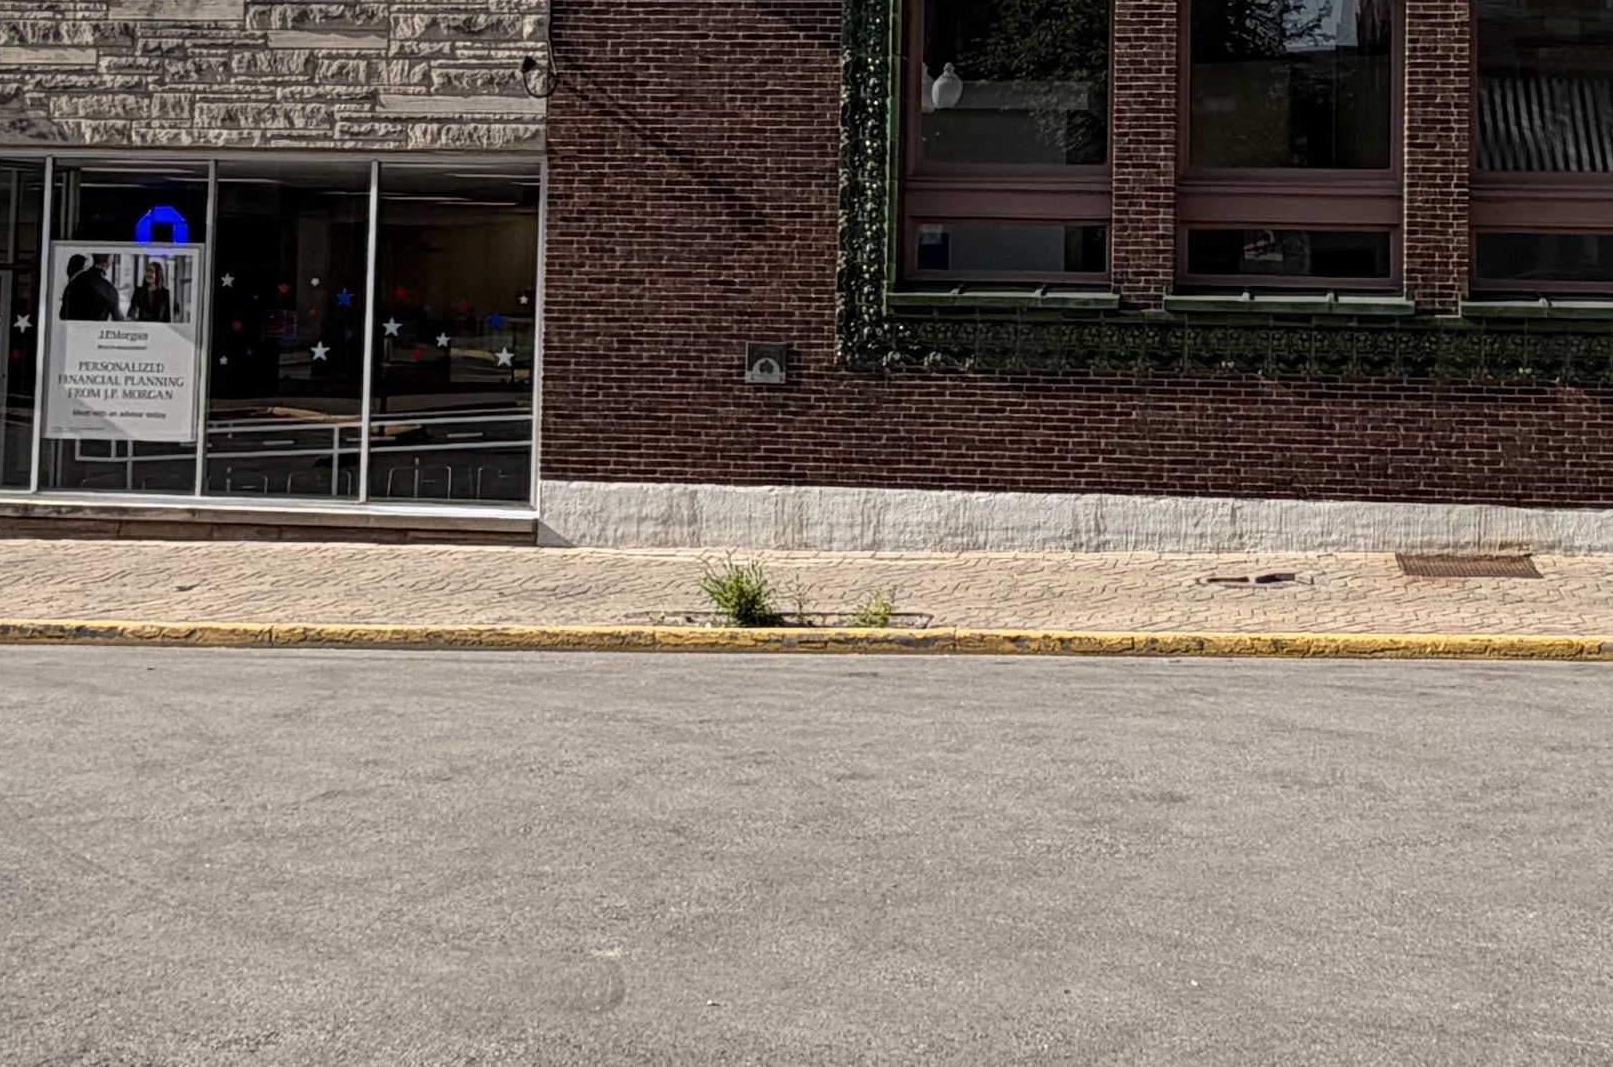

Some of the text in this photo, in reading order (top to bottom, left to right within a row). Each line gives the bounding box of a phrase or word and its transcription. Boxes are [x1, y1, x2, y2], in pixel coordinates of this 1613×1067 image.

[79, 361, 164, 373] PERSONALIZED
[58, 374, 184, 387] FINANCIAL PLANNING
[68, 387, 100, 398] FROM
[122, 389, 173, 400] MORGAN
